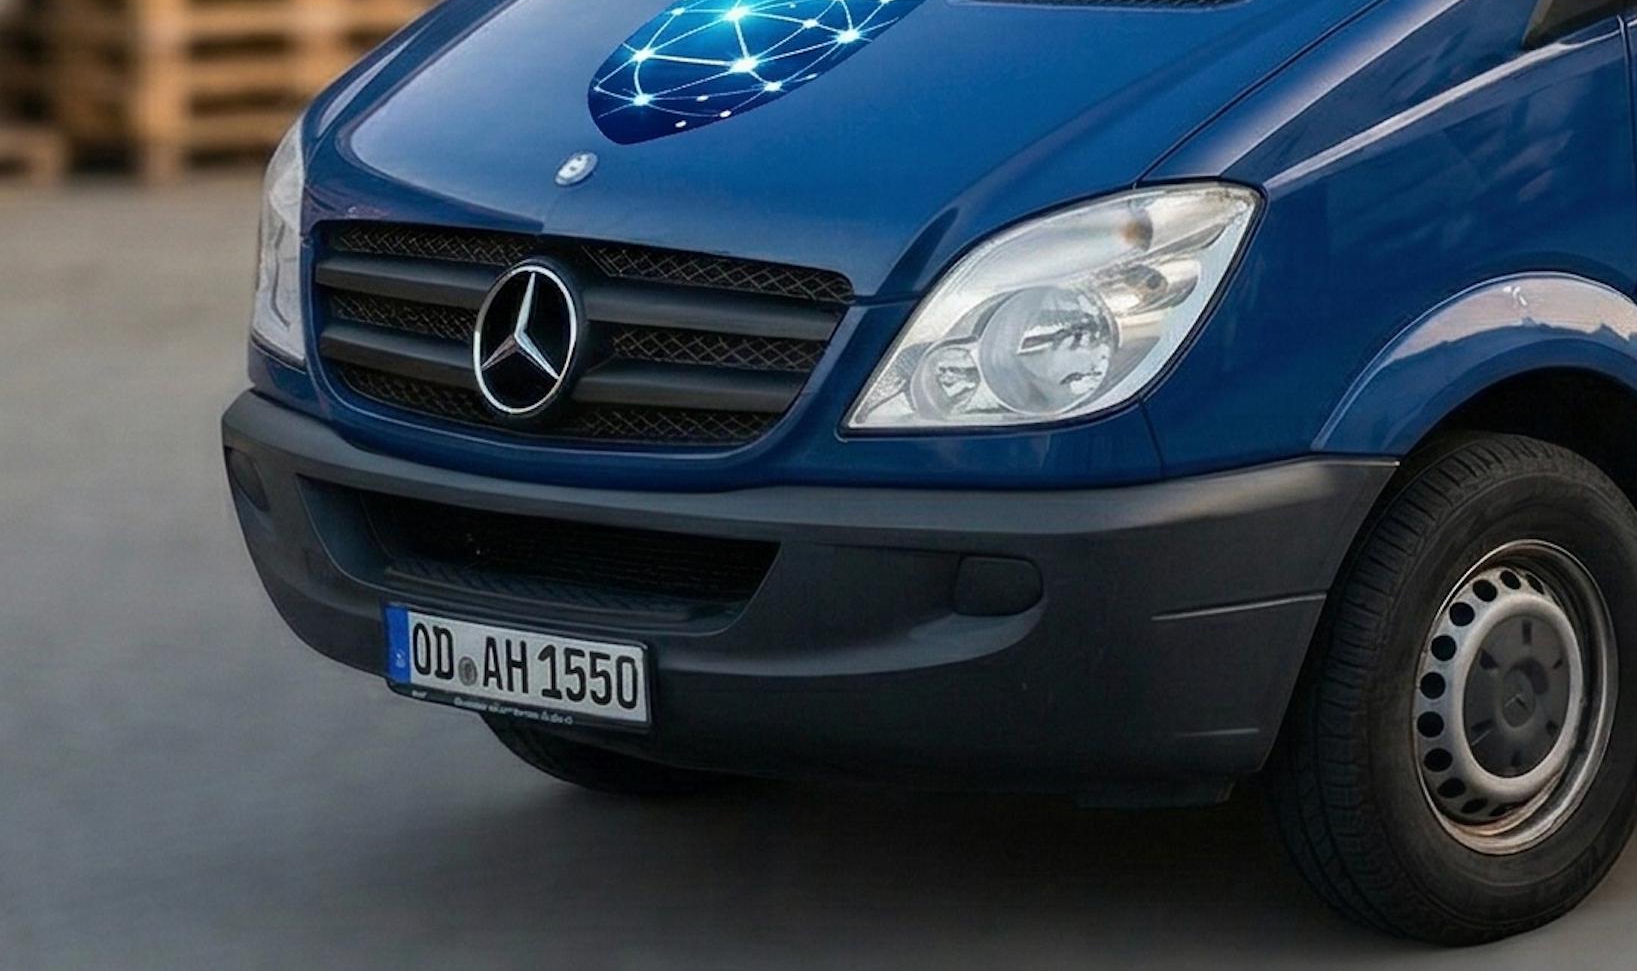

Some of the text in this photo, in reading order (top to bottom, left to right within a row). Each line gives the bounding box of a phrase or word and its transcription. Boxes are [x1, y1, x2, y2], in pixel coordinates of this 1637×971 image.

[412, 622, 638, 709] OD AH 1550
